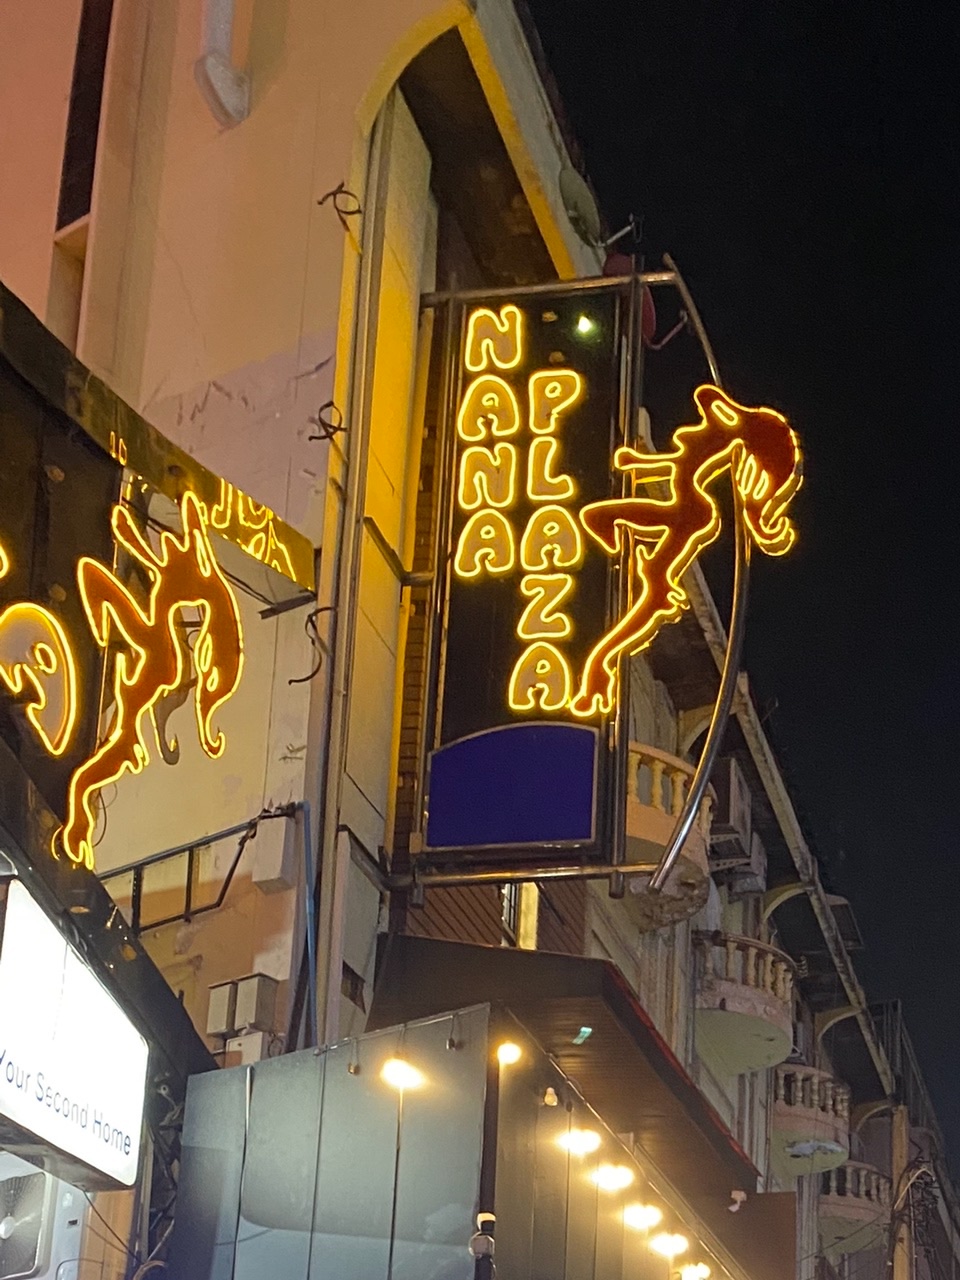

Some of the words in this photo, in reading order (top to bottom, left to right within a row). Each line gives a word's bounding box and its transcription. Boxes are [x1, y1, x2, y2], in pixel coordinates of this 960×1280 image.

[456, 306, 521, 576] NANA
[508, 369, 583, 711] PLAZA
[35, 1072, 89, 1128] Second
[93, 1109, 131, 1155] Home
